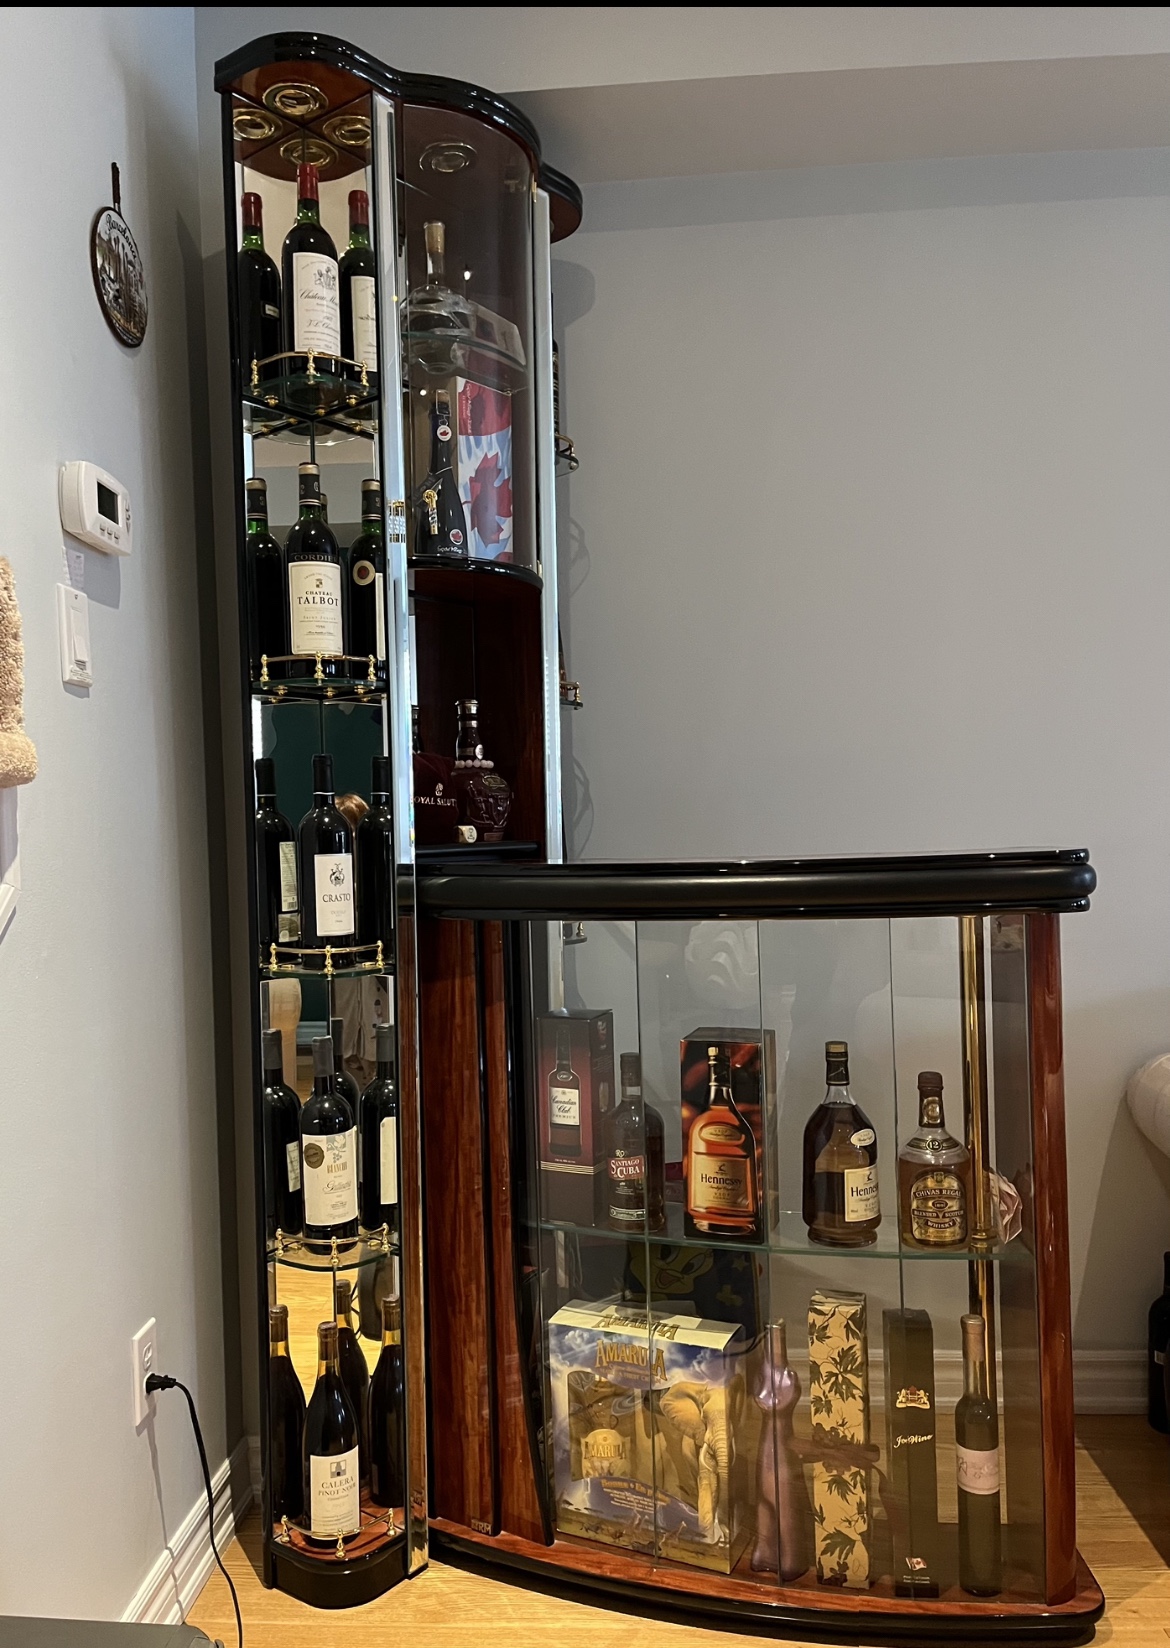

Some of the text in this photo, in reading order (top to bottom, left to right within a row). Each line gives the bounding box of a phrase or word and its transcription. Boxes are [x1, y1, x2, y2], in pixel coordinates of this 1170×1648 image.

[297, 597, 339, 607] TALBOT
[413, 796, 457, 806] OYAL SALUT
[322, 893, 351, 903] CRASTO
[557, 1105, 571, 1113] Club
[611, 1159, 640, 1174] SANTIAGO
[617, 1166, 640, 1178] CUBA
[701, 1173, 741, 1186] Hennessy
[915, 1189, 940, 1198] CHIVAS
[927, 1220, 953, 1228] WHISKY
[595, 1340, 668, 1381] AMARUA
[321, 1475, 354, 1490] CALERA
[318, 1488, 340, 1497] PINOT
